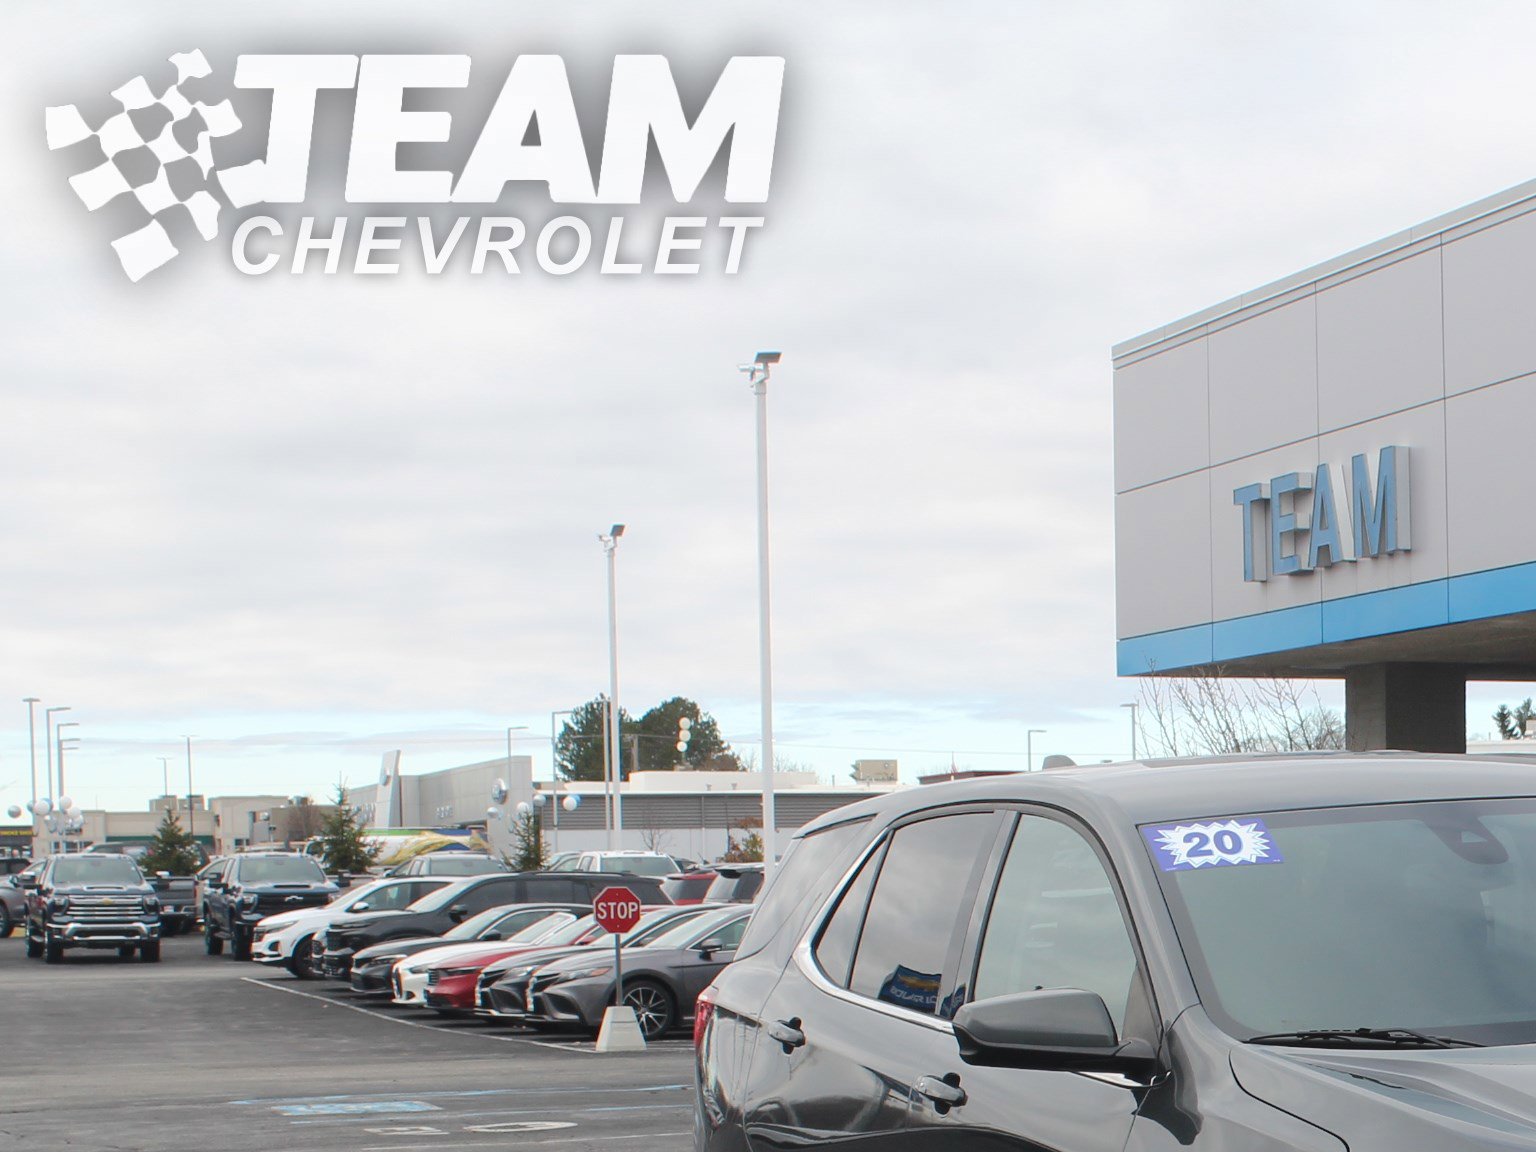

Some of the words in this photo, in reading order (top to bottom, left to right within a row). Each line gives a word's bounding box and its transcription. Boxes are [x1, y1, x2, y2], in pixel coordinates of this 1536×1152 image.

[1233, 445, 1411, 582] TEAM
[1183, 829, 1243, 858] 20
[597, 901, 638, 920] STOP
